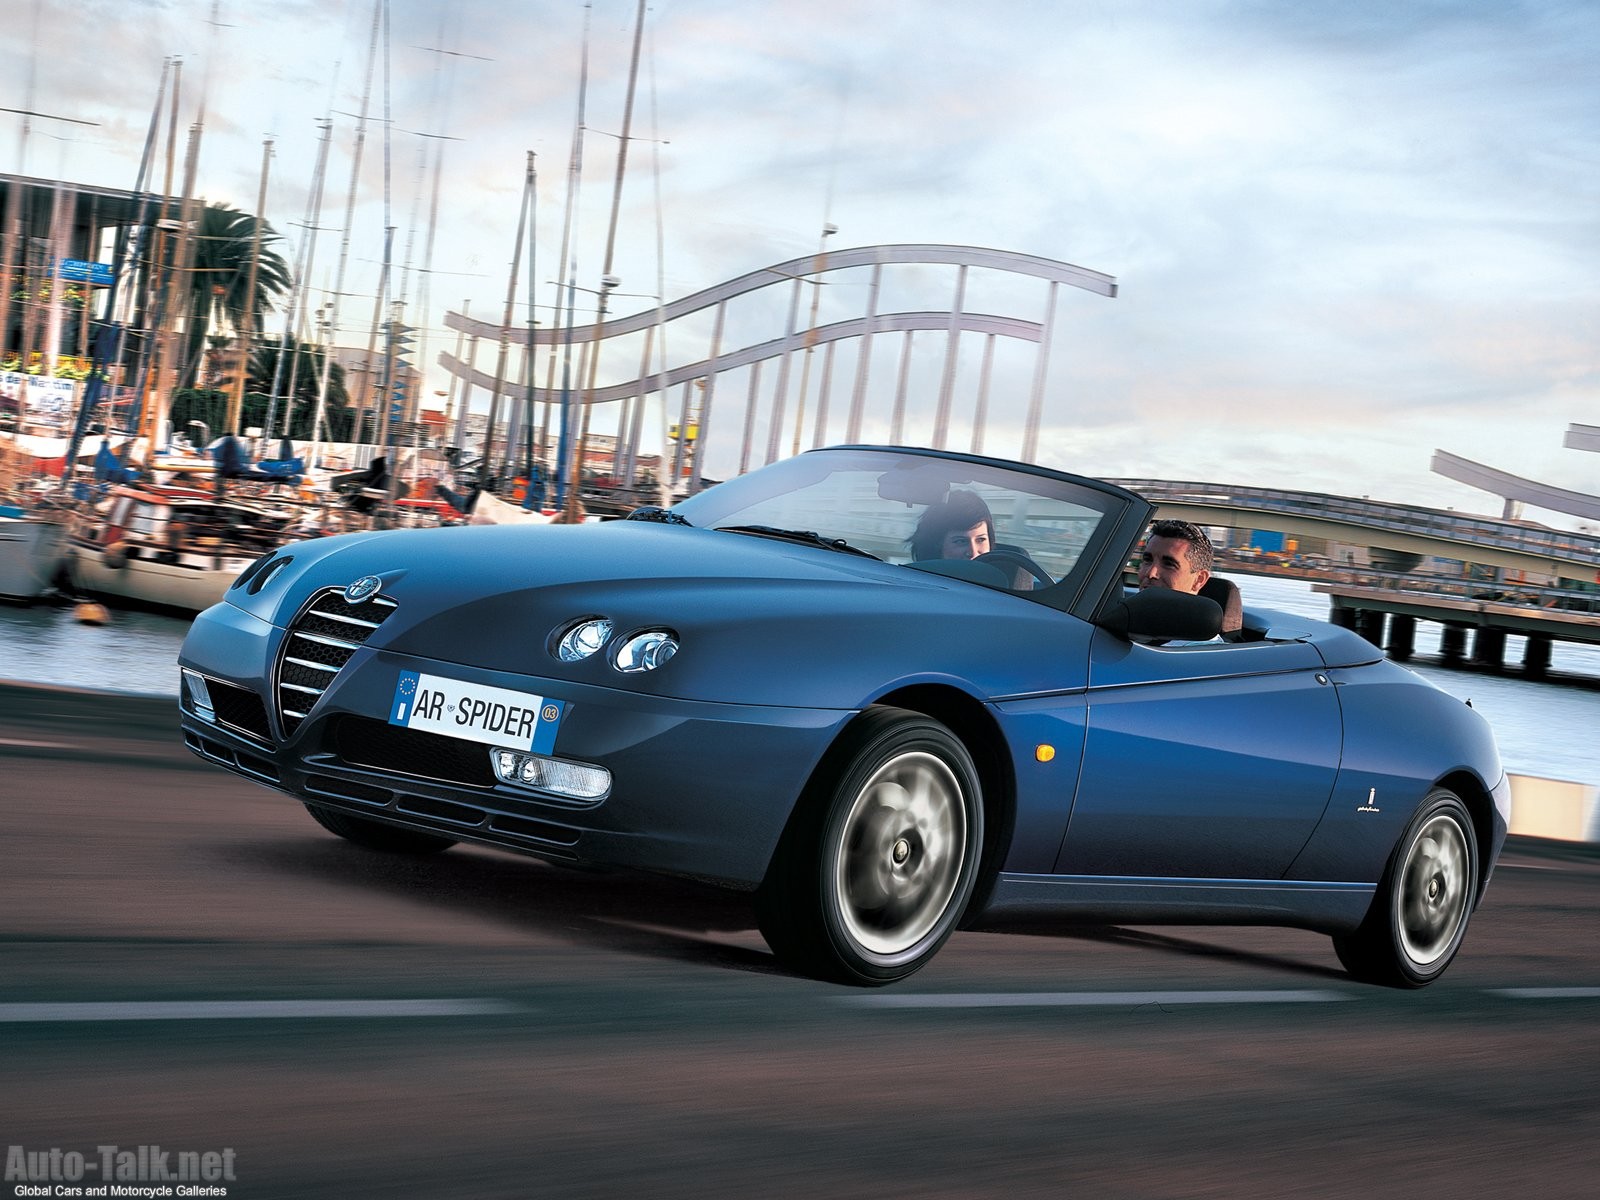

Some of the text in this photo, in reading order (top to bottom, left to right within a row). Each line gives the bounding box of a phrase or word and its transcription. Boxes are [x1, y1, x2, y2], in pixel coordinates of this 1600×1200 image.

[412, 689, 535, 739] AR SPIDER
[544, 708, 557, 720] 03
